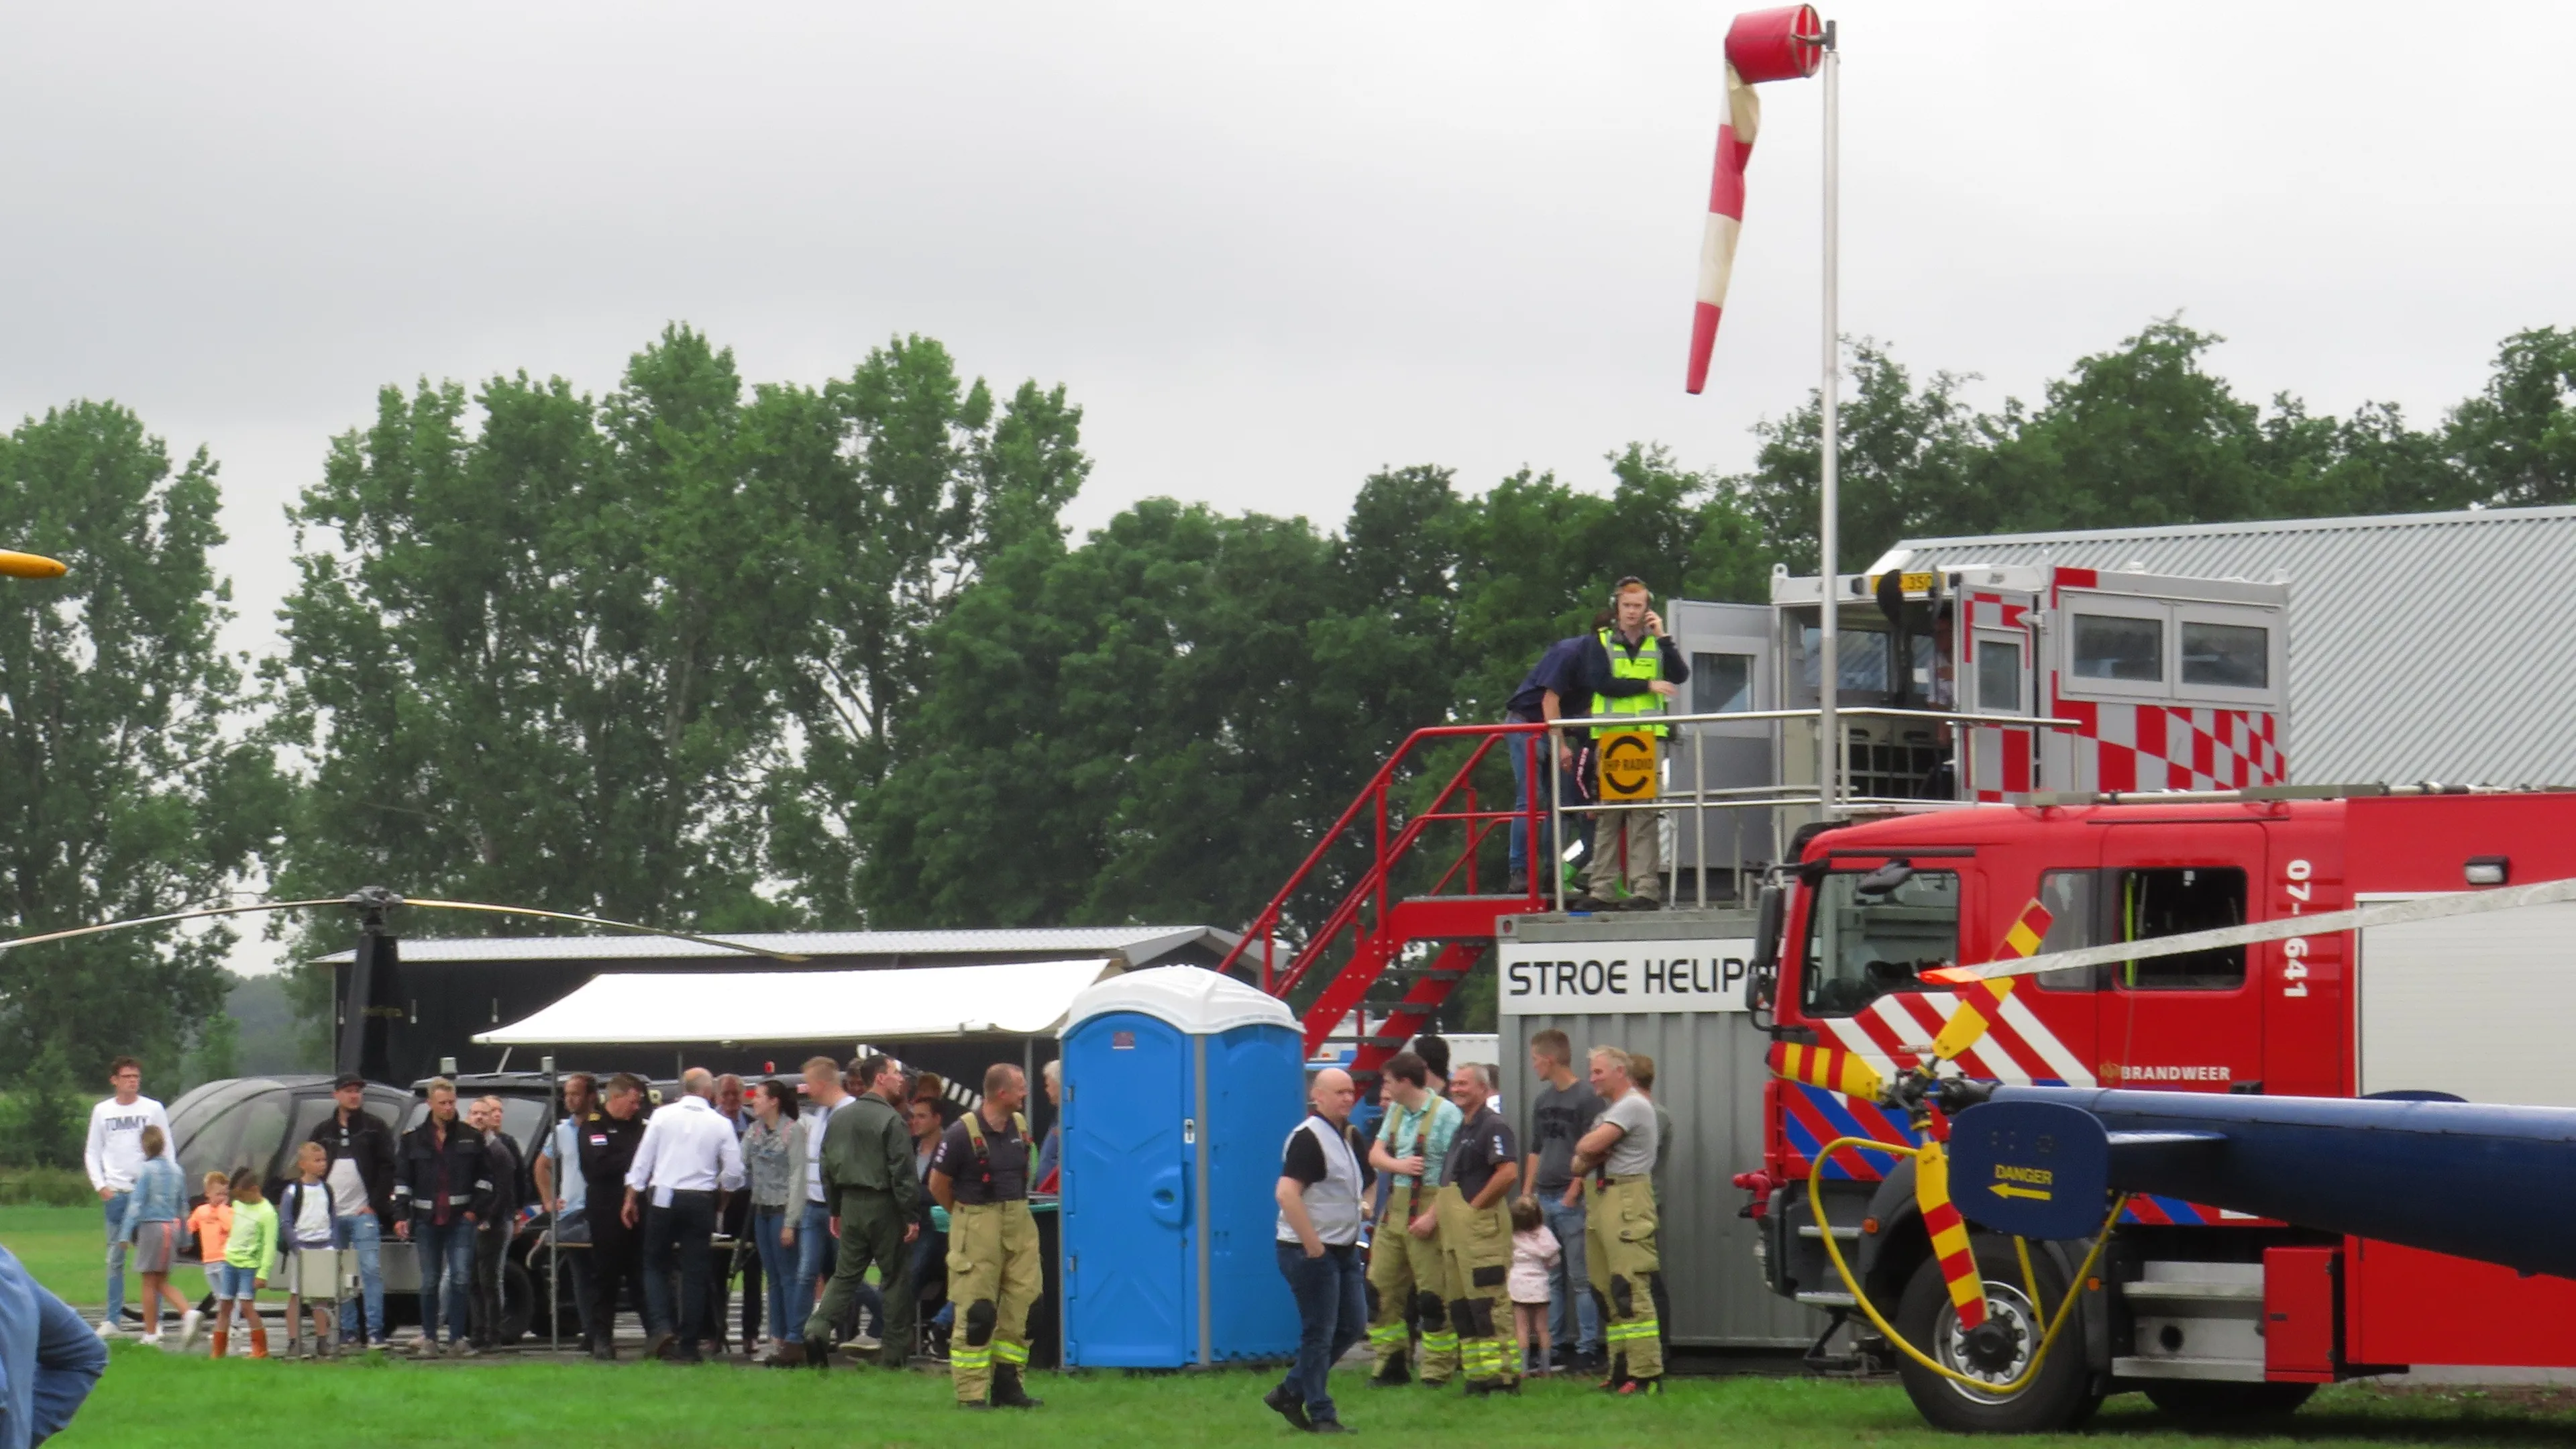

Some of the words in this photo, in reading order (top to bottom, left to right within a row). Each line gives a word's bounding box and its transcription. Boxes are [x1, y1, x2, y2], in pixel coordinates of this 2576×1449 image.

[2284, 859, 2312, 997] 07-641
[1509, 959, 1628, 996] STROE
[1644, 958, 1755, 994] HELIP
[2121, 1066, 2231, 1081] BRANDWEER
[105, 1116, 149, 1131] TOMMY
[1994, 1163, 2053, 1185] DANGER
